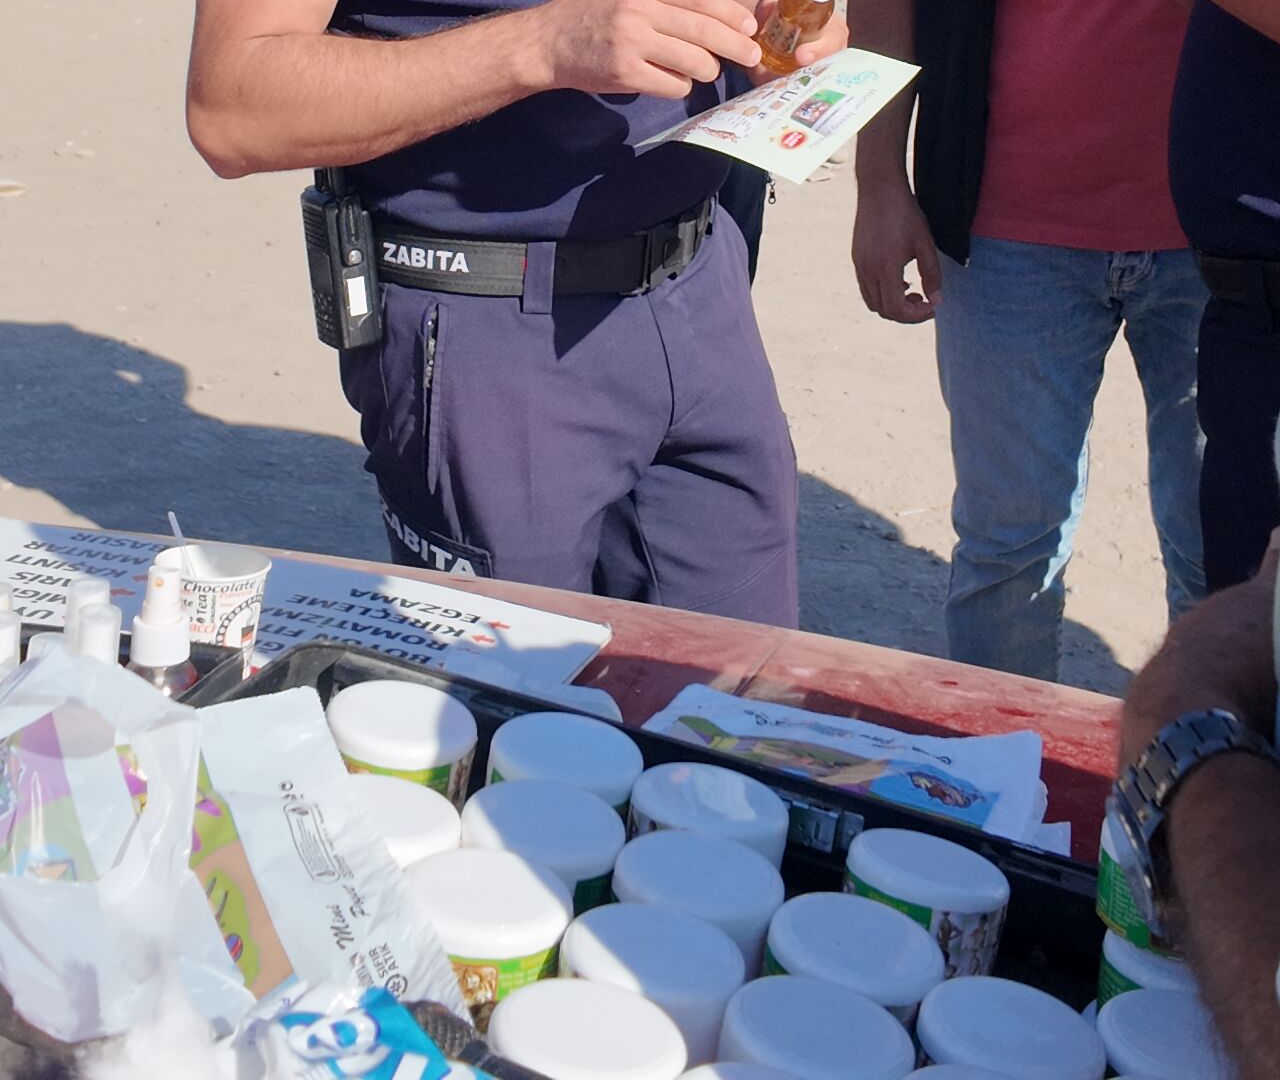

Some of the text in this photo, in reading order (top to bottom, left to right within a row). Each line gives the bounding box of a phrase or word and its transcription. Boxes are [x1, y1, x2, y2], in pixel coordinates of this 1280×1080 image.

[383, 242, 470, 273] ZABITA
[23, 540, 150, 566] MANTAR
[5, 554, 128, 579] KAŞINTI
[183, 580, 256, 593] Chocolate
[196, 594, 208, 614] Tea
[286, 593, 466, 637] KİREÇLEME
[350, 587, 481, 624] EGZAMA
